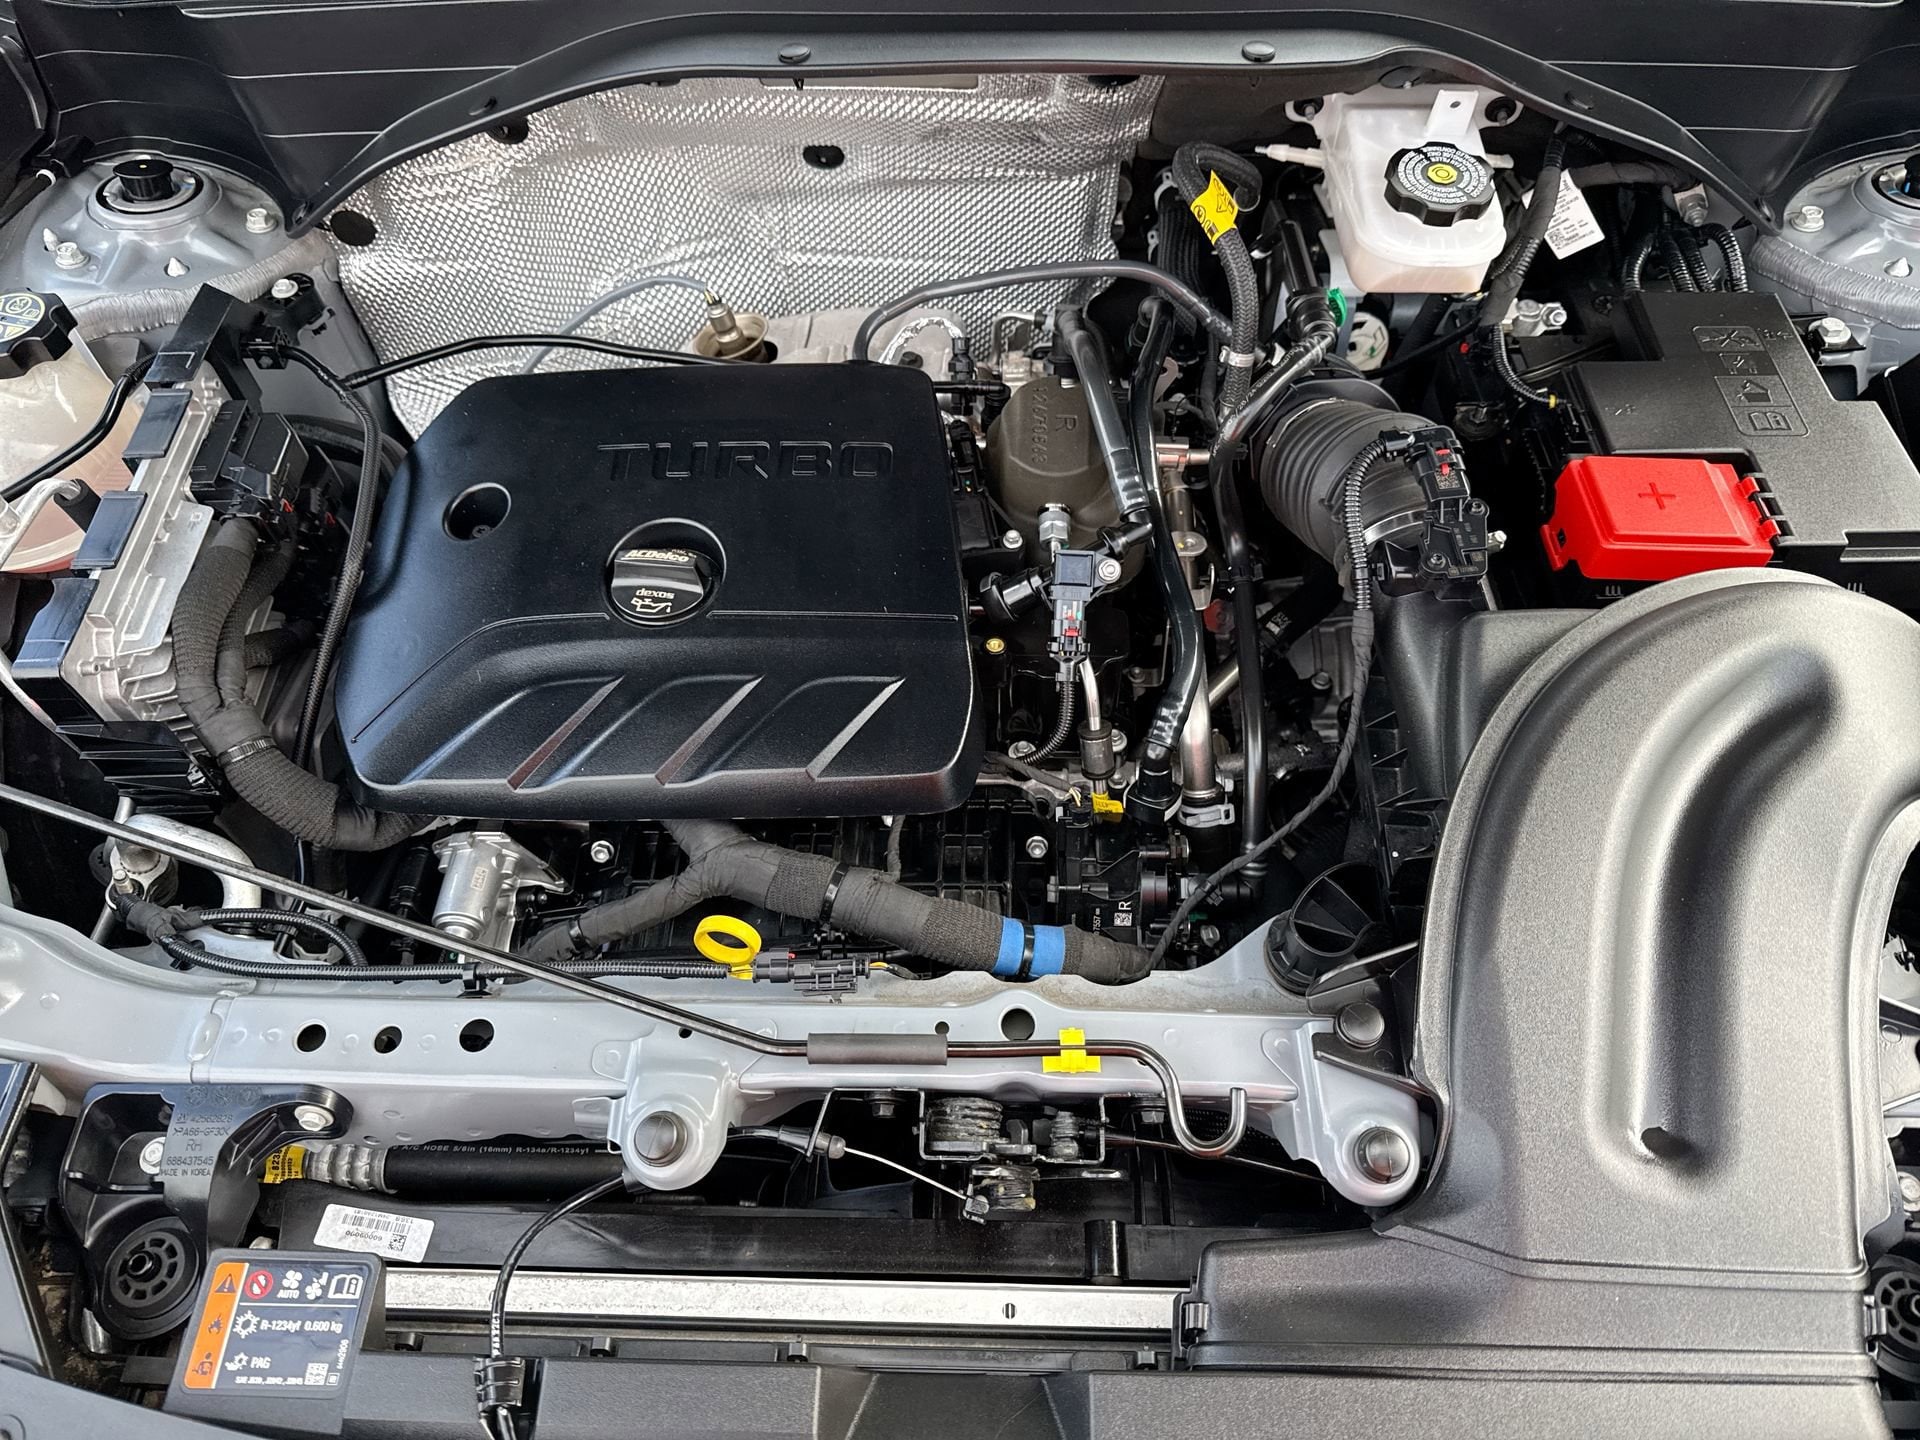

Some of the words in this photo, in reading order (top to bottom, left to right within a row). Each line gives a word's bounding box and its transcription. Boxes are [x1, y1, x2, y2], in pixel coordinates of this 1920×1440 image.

[1056, 413, 1078, 432] R
[597, 441, 893, 481] TURBO
[621, 549, 690, 562] ACDelco
[635, 588, 675, 599] dexos
[1118, 901, 1132, 910] R
[185, 1139, 202, 1151] RH
[479, 1146, 512, 1154] (16mm)
[166, 1156, 214, 1166] 688437545
[181, 1168, 189, 1177] IN
[190, 1168, 212, 1177] KOREA
[277, 1289, 300, 1299] AUTO
[259, 1319, 302, 1333] R-1234yf
[303, 1320, 330, 1332] 0.600
[331, 1321, 344, 1333] kg
[250, 1357, 271, 1369] PAG
